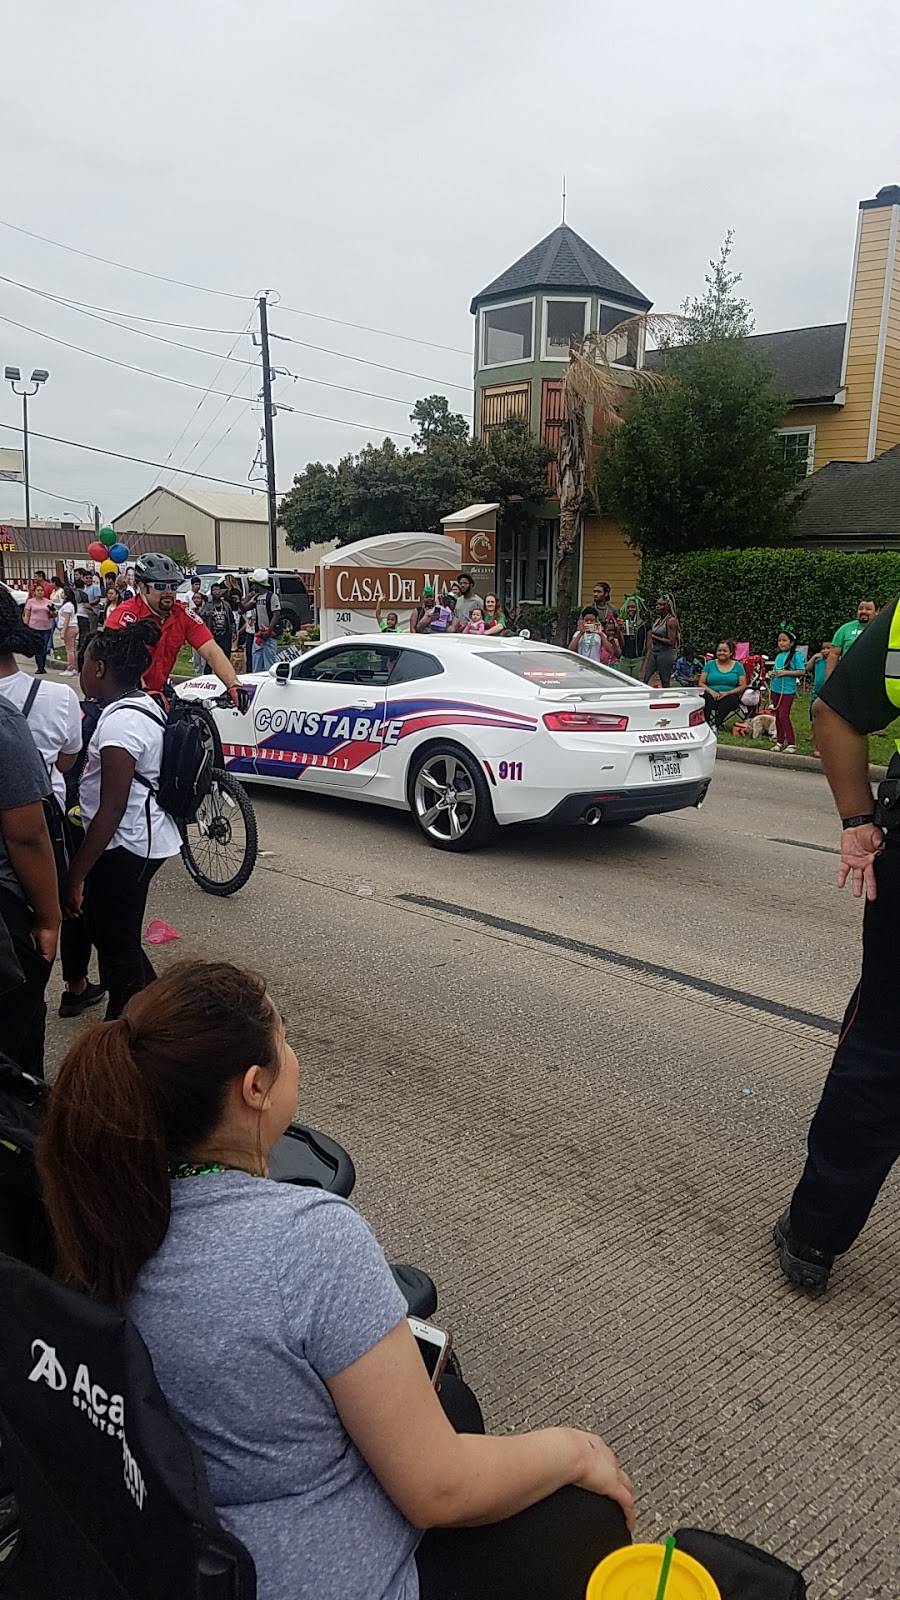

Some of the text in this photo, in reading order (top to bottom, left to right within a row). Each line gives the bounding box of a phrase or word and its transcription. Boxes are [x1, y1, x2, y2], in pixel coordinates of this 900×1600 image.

[388, 572, 421, 602] DEL
[336, 612, 351, 622] 2431
[255, 709, 403, 745] CONSTABLE
[638, 732, 679, 743] CONSTABLE
[229, 745, 350, 770] HARRIS COUNTY
[498, 760, 523, 781] 911
